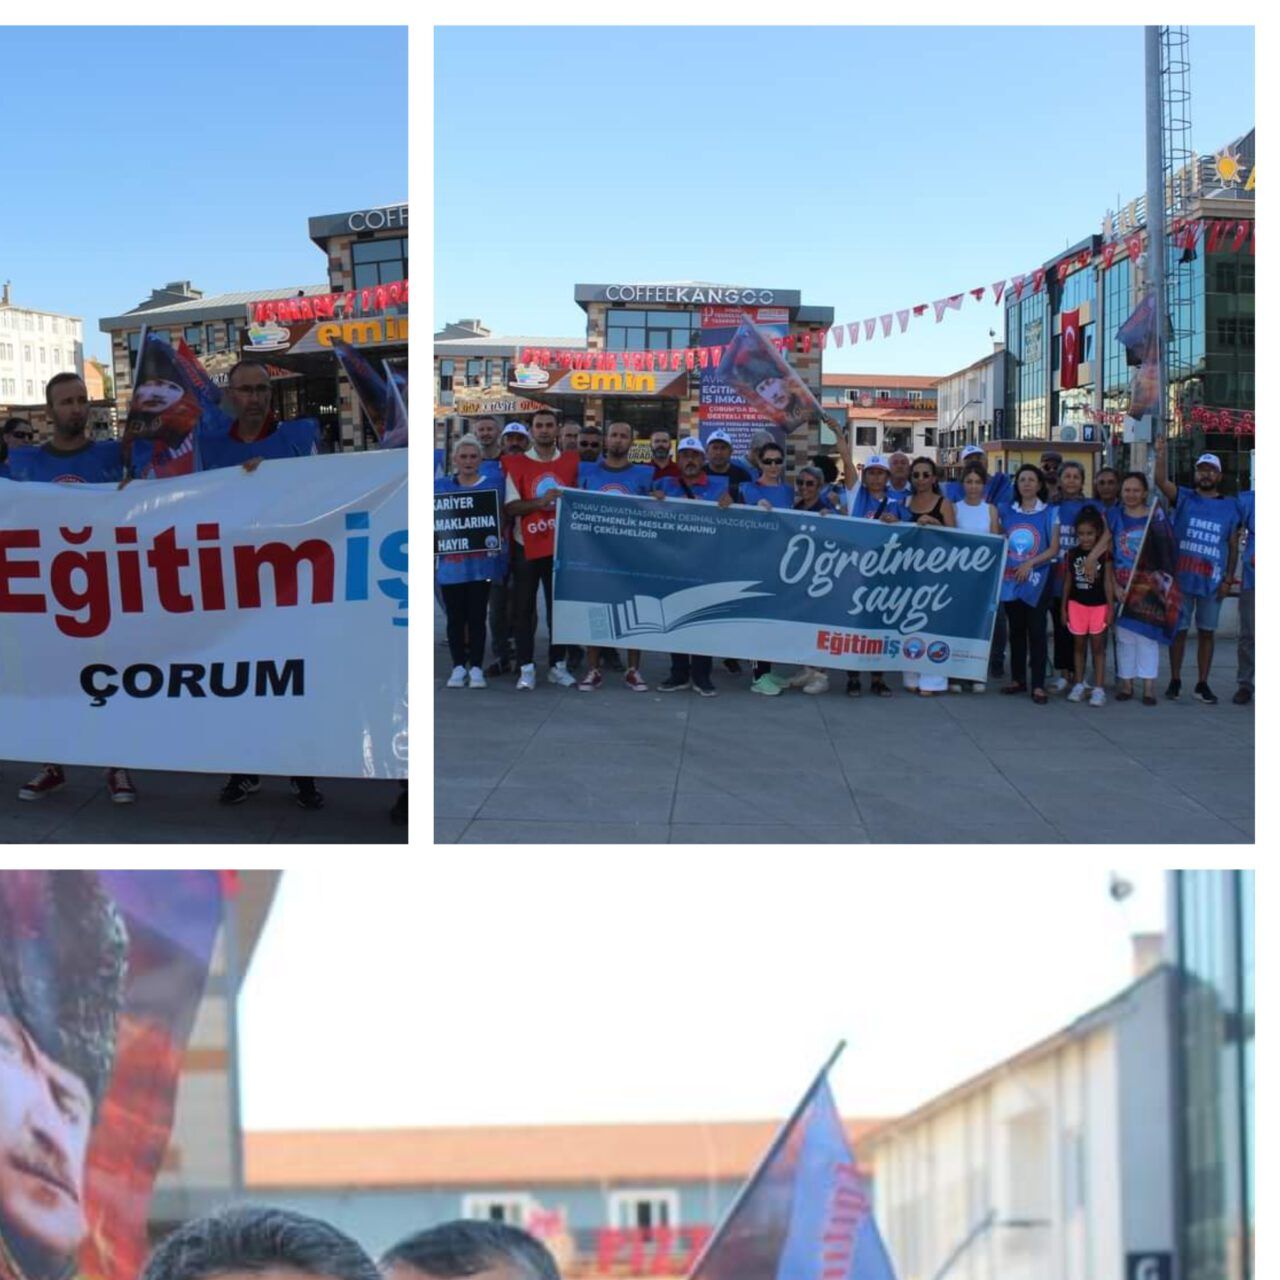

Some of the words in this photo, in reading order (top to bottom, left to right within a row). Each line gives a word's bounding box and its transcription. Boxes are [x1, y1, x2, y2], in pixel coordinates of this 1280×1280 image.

[348, 206, 408, 232] COFF
[571, 370, 657, 393] emin
[638, 520, 675, 531] MESLEK
[677, 524, 717, 535] KANUNU
[438, 538, 469, 551] HAYIR
[780, 523, 996, 597] Öğretmene
[848, 582, 954, 635] saygı
[79, 658, 305, 707] ÇORUM
